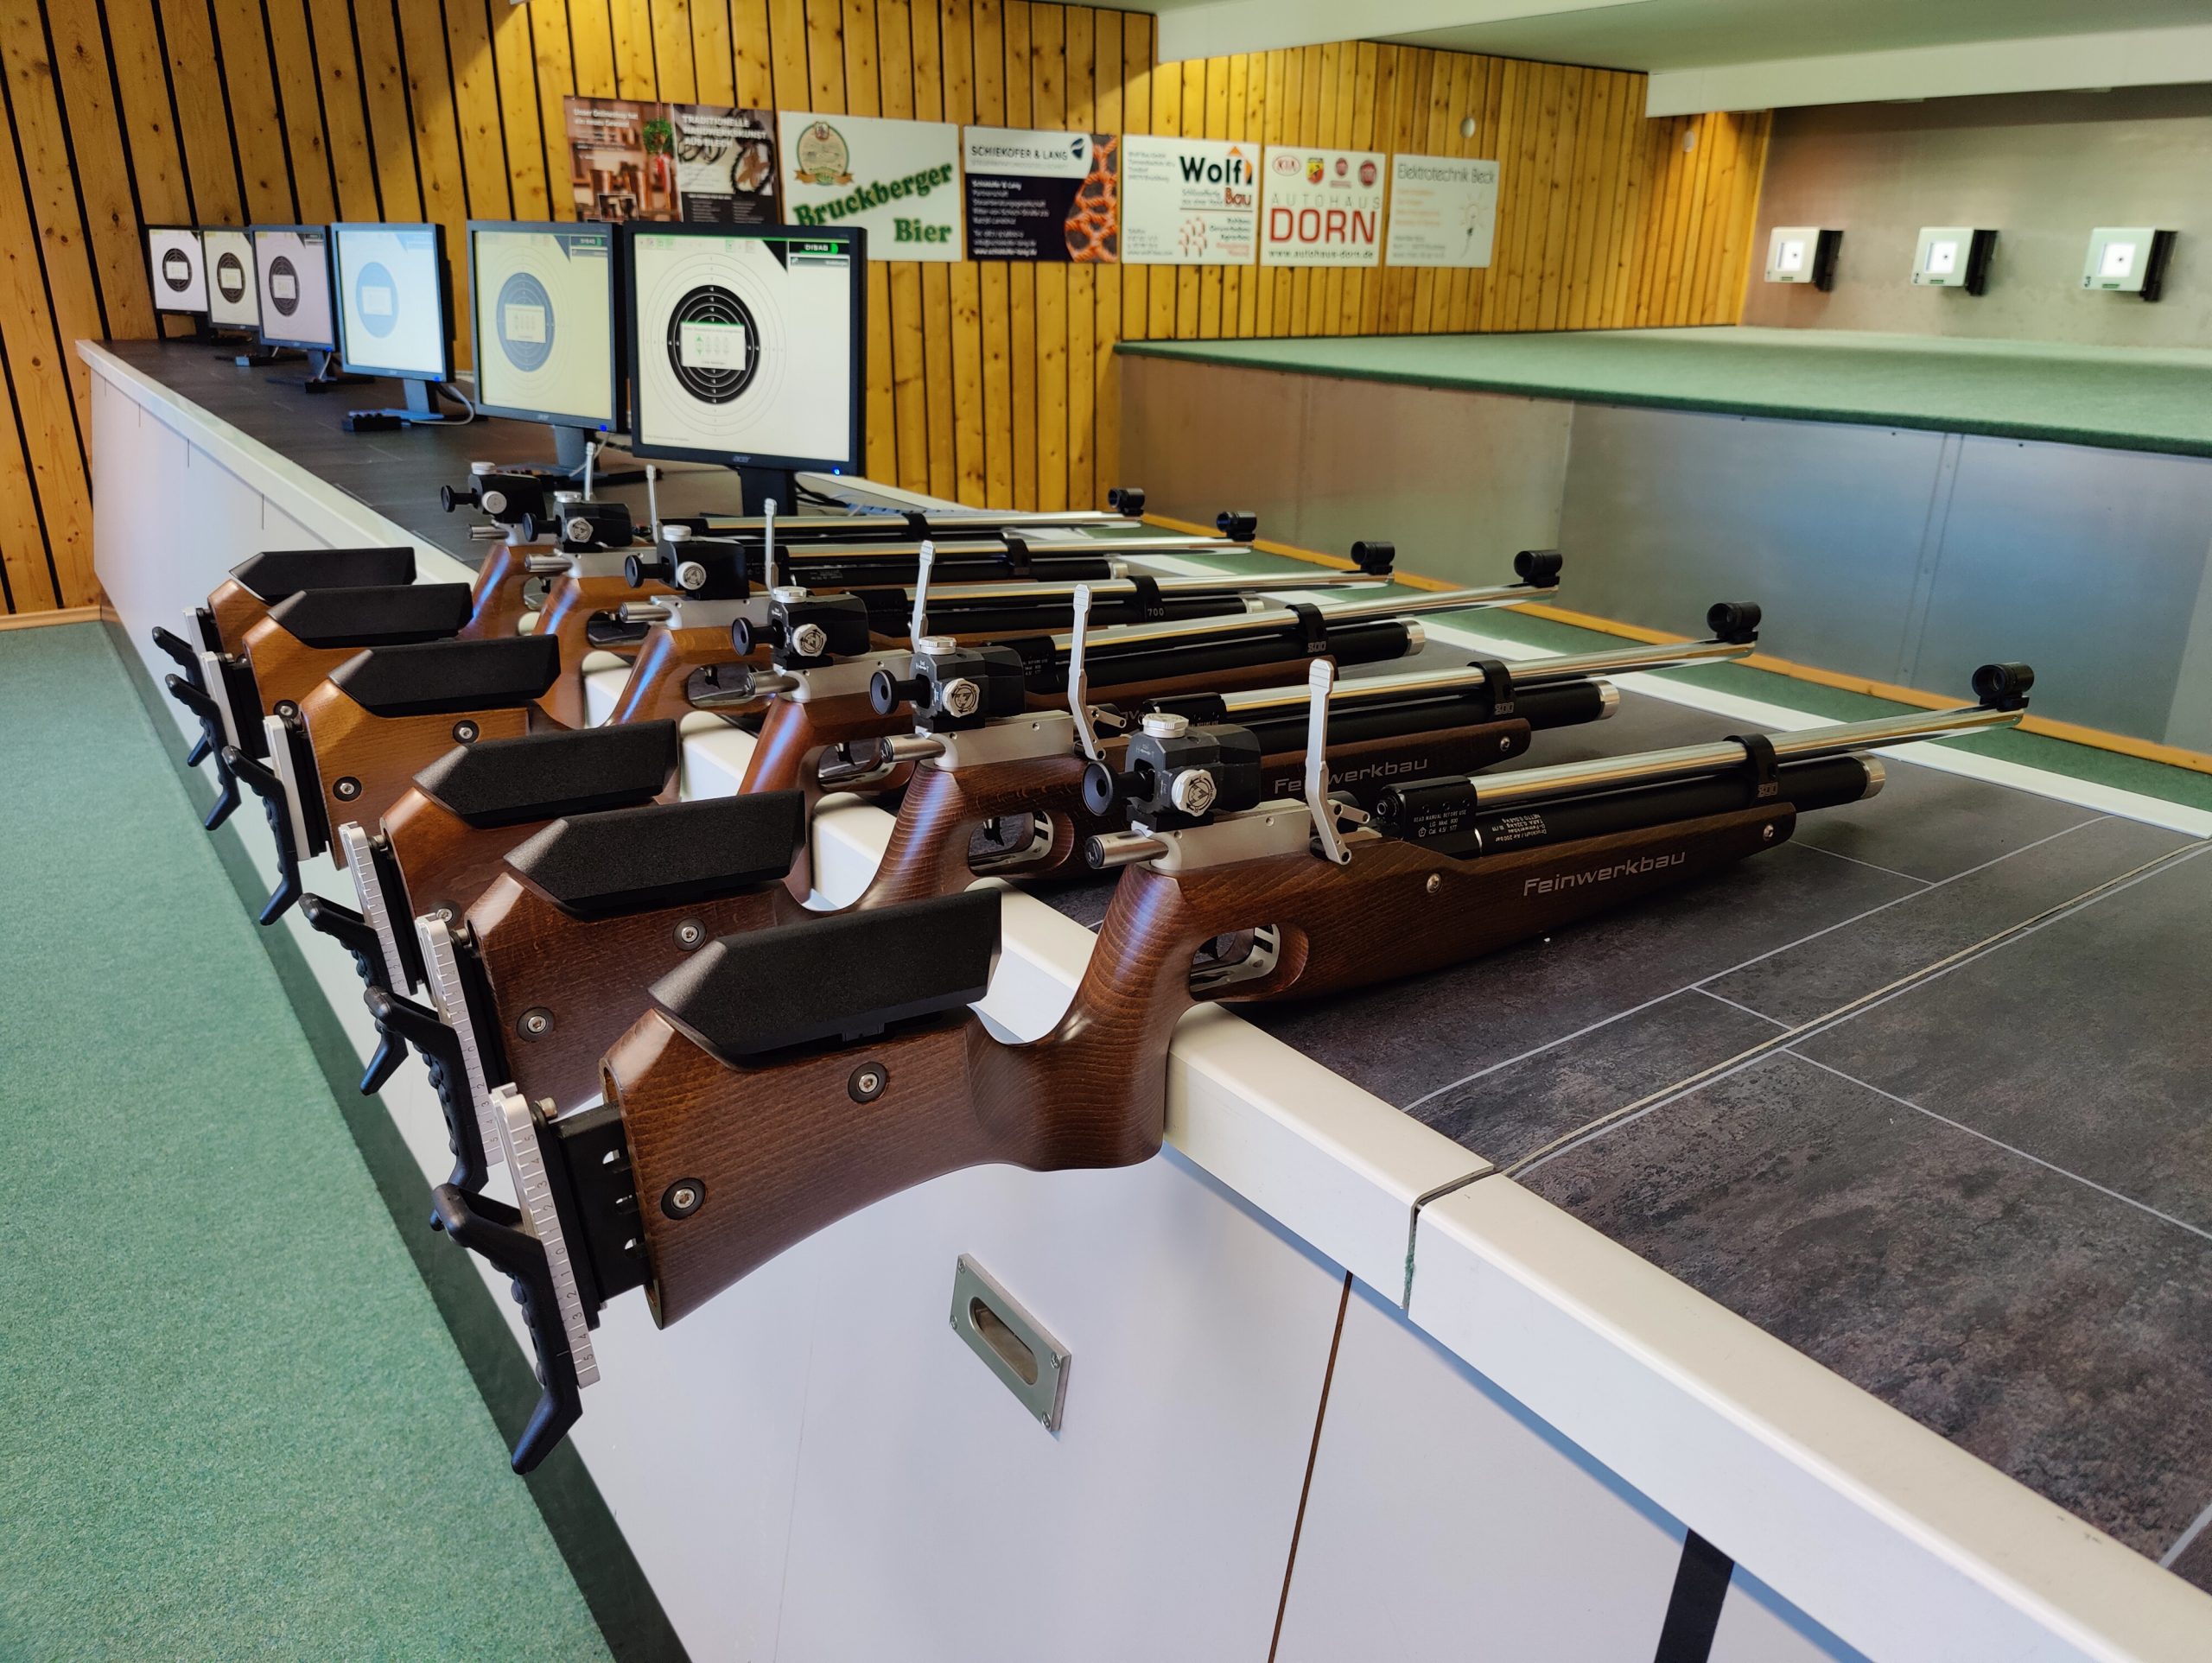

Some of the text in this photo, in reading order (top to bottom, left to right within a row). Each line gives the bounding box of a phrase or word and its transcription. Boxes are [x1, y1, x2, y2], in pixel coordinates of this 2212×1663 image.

[682, 114, 750, 129] TRADITIONELLE
[971, 146, 1031, 159] SCHIEKOFER
[1179, 156, 1243, 185] Wolf
[1396, 162, 1468, 183] Elektrotechnik
[1471, 168, 1495, 185] Beck
[793, 162, 953, 225] Bruckberger
[1272, 193, 1380, 209] AUTOHAUS
[893, 218, 953, 243] Bier
[1270, 207, 1376, 244] DORN
[1147, 607, 1165, 617] 700
[1274, 759, 1427, 795] Fewerkbau
[1522, 852, 1685, 897] Feinwerkbau
[524, 1133, 535, 1142] 5
[537, 1180, 547, 1189] 3
[543, 1203, 554, 1211] 2
[555, 1247, 566, 1255] 0
[566, 1290, 577, 1298] 2
[572, 1311, 582, 1320] 3
[583, 1353, 594, 1362] 5
